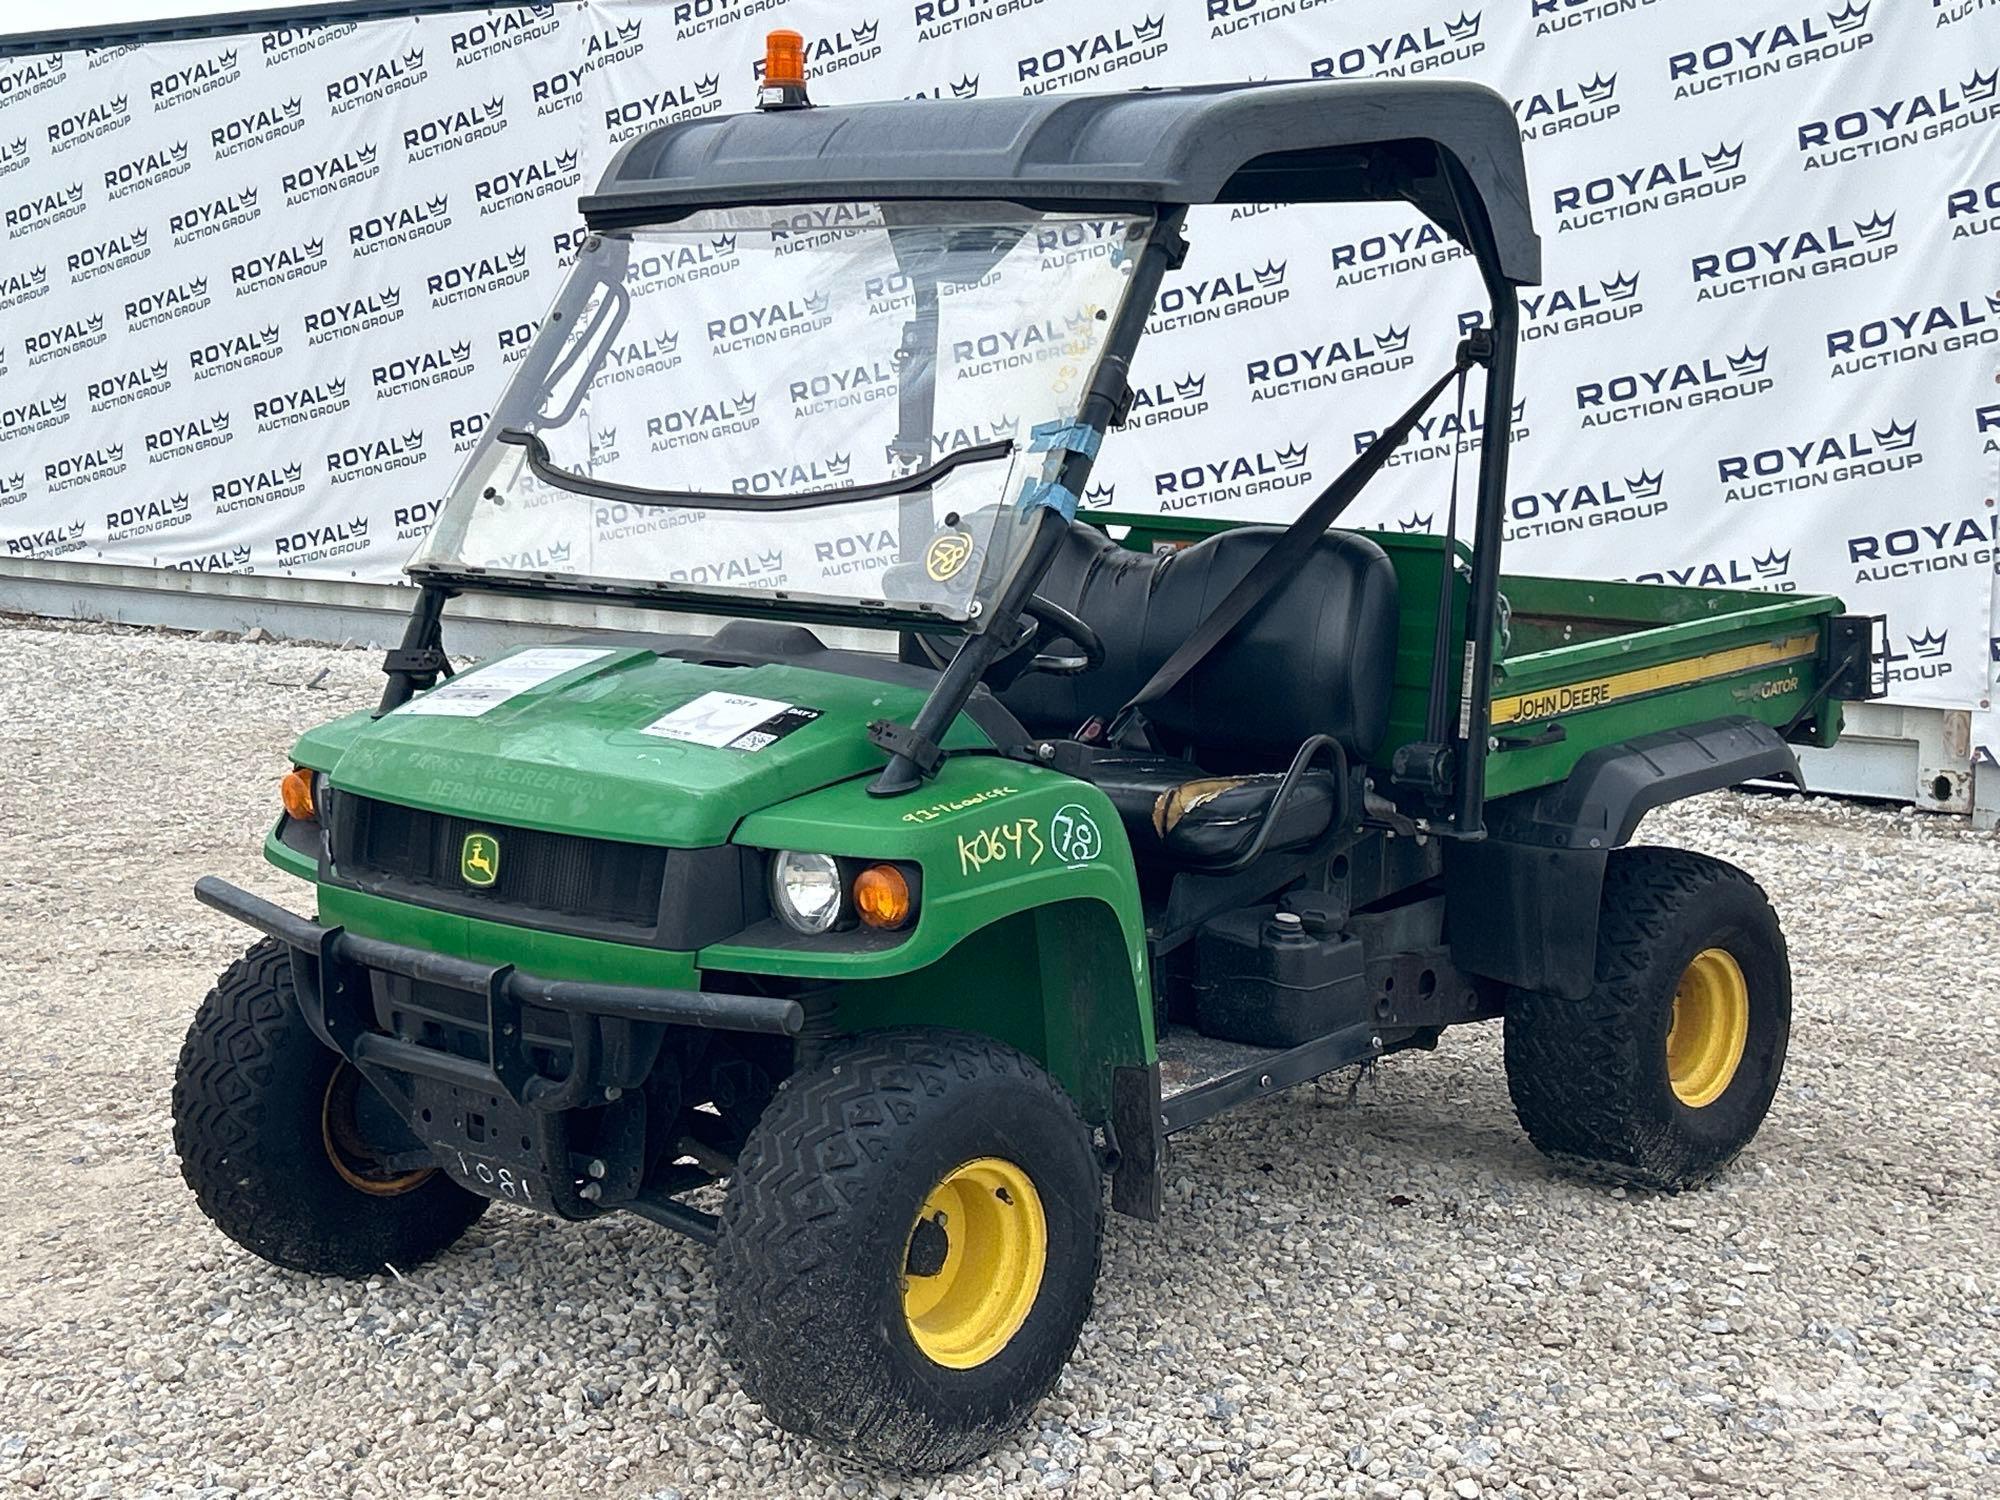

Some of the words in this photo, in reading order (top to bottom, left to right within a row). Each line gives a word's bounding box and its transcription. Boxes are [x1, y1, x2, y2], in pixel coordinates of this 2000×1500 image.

[451, 10, 534, 53] ROYAL
[457, 39, 512, 68] AUCTION
[514, 20, 559, 45] GROUP
[1670, 18, 1827, 80] ROYAL
[1018, 30, 1133, 81] ROYAL
[1104, 43, 1167, 72] GROUP
[1411, 43, 1485, 73] GROUP
[1675, 60, 1780, 100] AUCTION
[1787, 33, 1873, 69] GROUP
[151, 60, 219, 99] ROYAL
[155, 87, 200, 112] AUCTION
[203, 71, 240, 93] GROUP
[327, 60, 403, 102] ROYAL
[331, 88, 383, 116] AUCTION
[385, 71, 427, 95] GROUP
[48, 105, 111, 142] ROYAL
[606, 86, 695, 129] ROYAL
[672, 99, 722, 125] GROUP
[1543, 104, 1620, 136] GROUP
[1799, 88, 1965, 151] ROYAL
[52, 130, 94, 155] AUCTION
[96, 115, 131, 136] GROUP
[212, 108, 283, 147] ROYAL
[216, 135, 264, 160] AUCTION
[266, 119, 304, 141] GROUP
[404, 107, 484, 149] ROYAL
[409, 136, 462, 163] AUCTION
[465, 120, 507, 143] GROUP
[105, 151, 171, 188] ROYAL
[1804, 131, 1917, 171] AUCTION
[109, 177, 153, 201] AUCTION
[155, 163, 191, 183] GROUP
[282, 154, 358, 193] ROYAL
[287, 181, 337, 207] AUCTION
[339, 166, 379, 188] GROUP
[475, 161, 556, 201] ROYAL
[1554, 158, 1702, 213] ROYAL
[6, 192, 67, 227] ROYAL
[481, 190, 534, 216] AUCTION
[536, 174, 580, 197] GROUP
[1559, 197, 1658, 233] AUCTION
[1664, 175, 1746, 206] GROUP
[10, 217, 51, 240] AUCTION
[52, 203, 86, 223] GROUP
[170, 197, 239, 233] ROYAL
[174, 224, 220, 247] AUCTION
[222, 209, 260, 229] GROUP
[350, 205, 428, 244] ROYAL
[68, 237, 131, 272] ROYAL
[354, 232, 407, 258] AUCTION
[409, 218, 451, 240] GROUP
[1692, 226, 1854, 282] ROYAL
[72, 262, 114, 284] AUCTION
[116, 248, 151, 268] GROUP
[232, 247, 305, 283] ROYAL
[236, 274, 285, 297] AUCTION
[287, 260, 327, 280] GROUP
[427, 256, 508, 294] ROYAL
[622, 244, 713, 283] ROYAL
[626, 274, 685, 300] AUCTION
[689, 259, 739, 281] GROUP
[1336, 255, 1426, 288] AUCTION
[1697, 266, 1805, 302] AUCTION
[1812, 244, 1898, 275] GROUP
[125, 286, 190, 320] ROYAL
[432, 284, 486, 308] AUCTION
[488, 270, 529, 291] GROUP
[1225, 289, 1289, 315] GROUP
[129, 311, 173, 333] AUCTION
[174, 298, 210, 317] GROUP
[305, 297, 381, 332] ROYAL
[309, 323, 360, 346] AUCTION
[362, 309, 403, 329] GROUP
[708, 301, 803, 341] ROYAL
[1565, 303, 1642, 331] GROUP
[1826, 301, 1985, 357] ROYAL
[25, 322, 87, 354] ROYAL
[29, 346, 71, 366] AUCTION
[73, 334, 107, 352] GROUP
[190, 334, 261, 368] ROYAL
[713, 331, 776, 356] AUCTION
[780, 317, 832, 338] GROUP
[954, 321, 1064, 363] ROYAL
[194, 359, 242, 381] AUCTION
[244, 347, 283, 366] GROUP
[373, 350, 451, 385] ROYAL
[958, 353, 1032, 380] AUCTION
[1247, 338, 1374, 384] ROYAL
[1831, 341, 1937, 378] AUCTION
[88, 369, 151, 401] ROYAL
[92, 393, 135, 413] AUCTION
[136, 381, 171, 399] GROUP
[377, 377, 430, 400] AUCTION
[432, 364, 474, 384] GROUP
[790, 363, 889, 403] ROYAL
[1252, 373, 1336, 402] AUCTION
[1342, 356, 1413, 381] GROUP
[1577, 359, 1726, 409] ROYAL
[254, 386, 328, 419] ROYAL
[258, 412, 308, 433] AUCTION
[310, 400, 350, 418] GROUP
[647, 401, 734, 437] ROYAL
[795, 392, 861, 419] AUCTION
[1145, 402, 1208, 425] GROUP
[1582, 397, 1682, 428] AUCTION
[1688, 379, 1773, 406] GROUP
[145, 420, 212, 451] ROYAL
[150, 444, 194, 464] AUCTION
[196, 433, 233, 450] GROUP
[651, 431, 708, 452] AUCTION
[712, 418, 759, 438] GROUP
[45, 451, 108, 480] ROYAL
[327, 438, 403, 471] ROYAL
[331, 464, 382, 485] AUCTION
[385, 453, 426, 471] GROUP
[1719, 433, 1872, 483] ROYAL
[49, 475, 91, 493] AUCTION
[93, 464, 126, 481] GROUP
[212, 470, 283, 501] ROYAL
[1156, 454, 1275, 495] ROYAL
[1160, 486, 1241, 512] AUCTION
[1246, 472, 1311, 495] GROUP
[1725, 472, 1827, 503] AUCTION
[1834, 453, 1921, 481] GROUP
[107, 500, 172, 529] ROYAL
[216, 495, 264, 514] AUCTION
[266, 484, 305, 501] GROUP
[1589, 502, 1668, 526] GROUP
[108, 524, 153, 543] AUCTION
[155, 513, 192, 530] GROUP
[276, 525, 349, 554] ROYAL
[279, 550, 327, 568] AUCTION
[330, 539, 370, 556] GROUP
[822, 556, 888, 577] AUCTION
[1856, 553, 1967, 583] AUCTION
[1513, 694, 1557, 721] JOHN
[1561, 683, 1611, 711] DEERE
[1761, 677, 1799, 699] GATOR
[427, 779, 554, 815] DEPARTMENT
